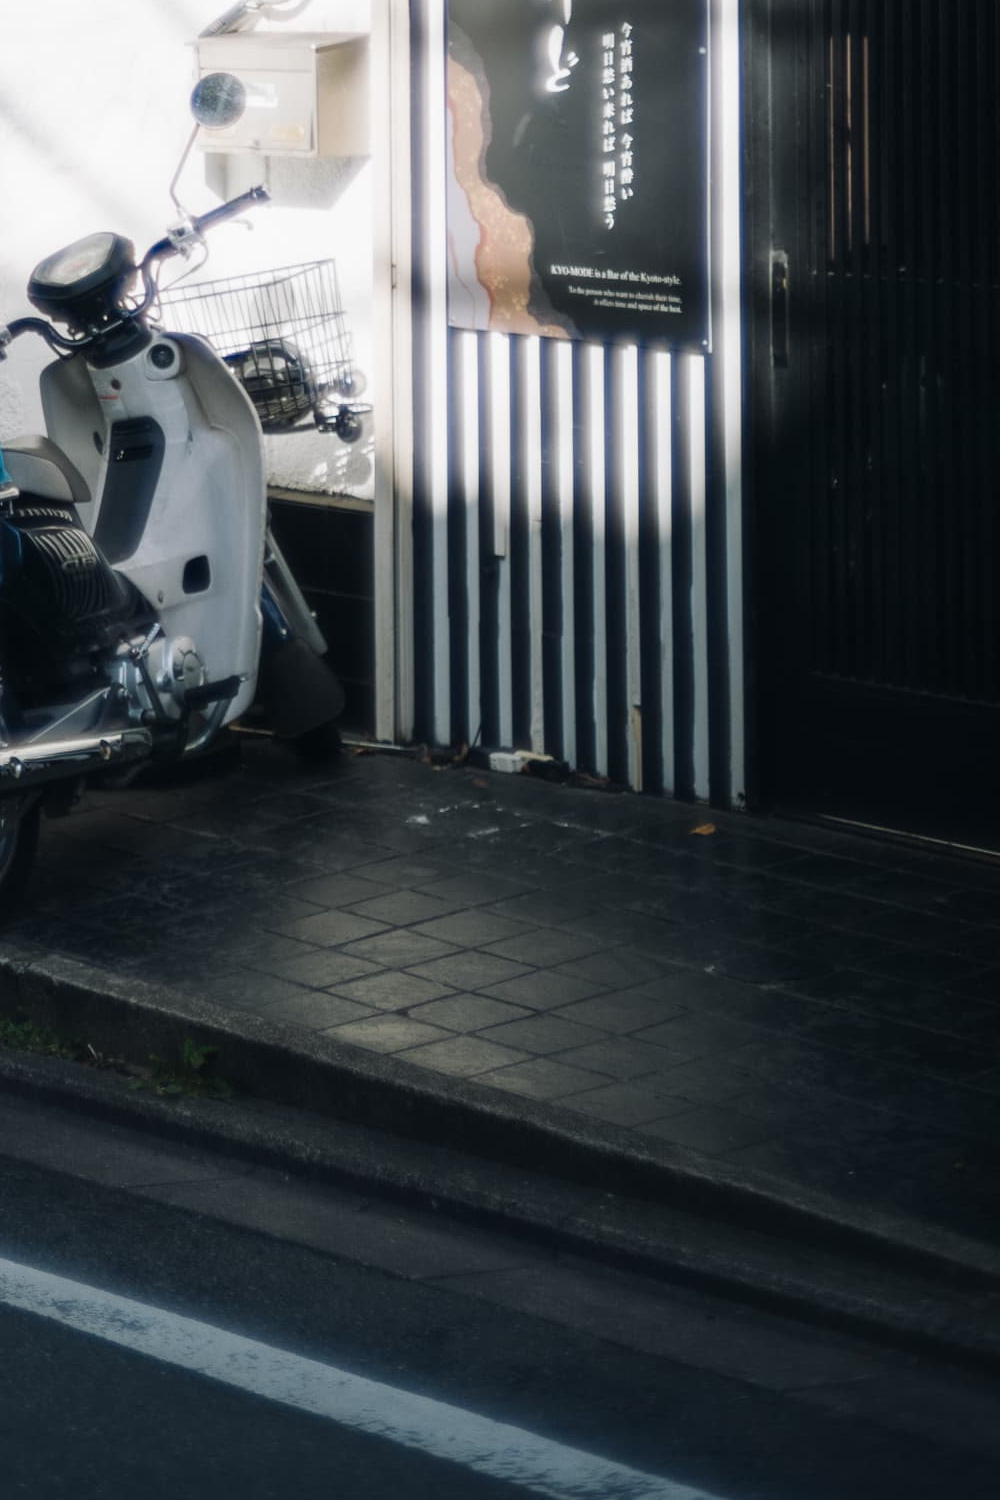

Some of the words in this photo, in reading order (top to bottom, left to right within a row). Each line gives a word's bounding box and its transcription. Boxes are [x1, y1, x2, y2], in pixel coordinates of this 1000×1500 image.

[550, 264, 594, 278] KYO-MODE
[607, 269, 619, 280] Bar
[620, 270, 628, 280] of
[629, 271, 640, 282] the
